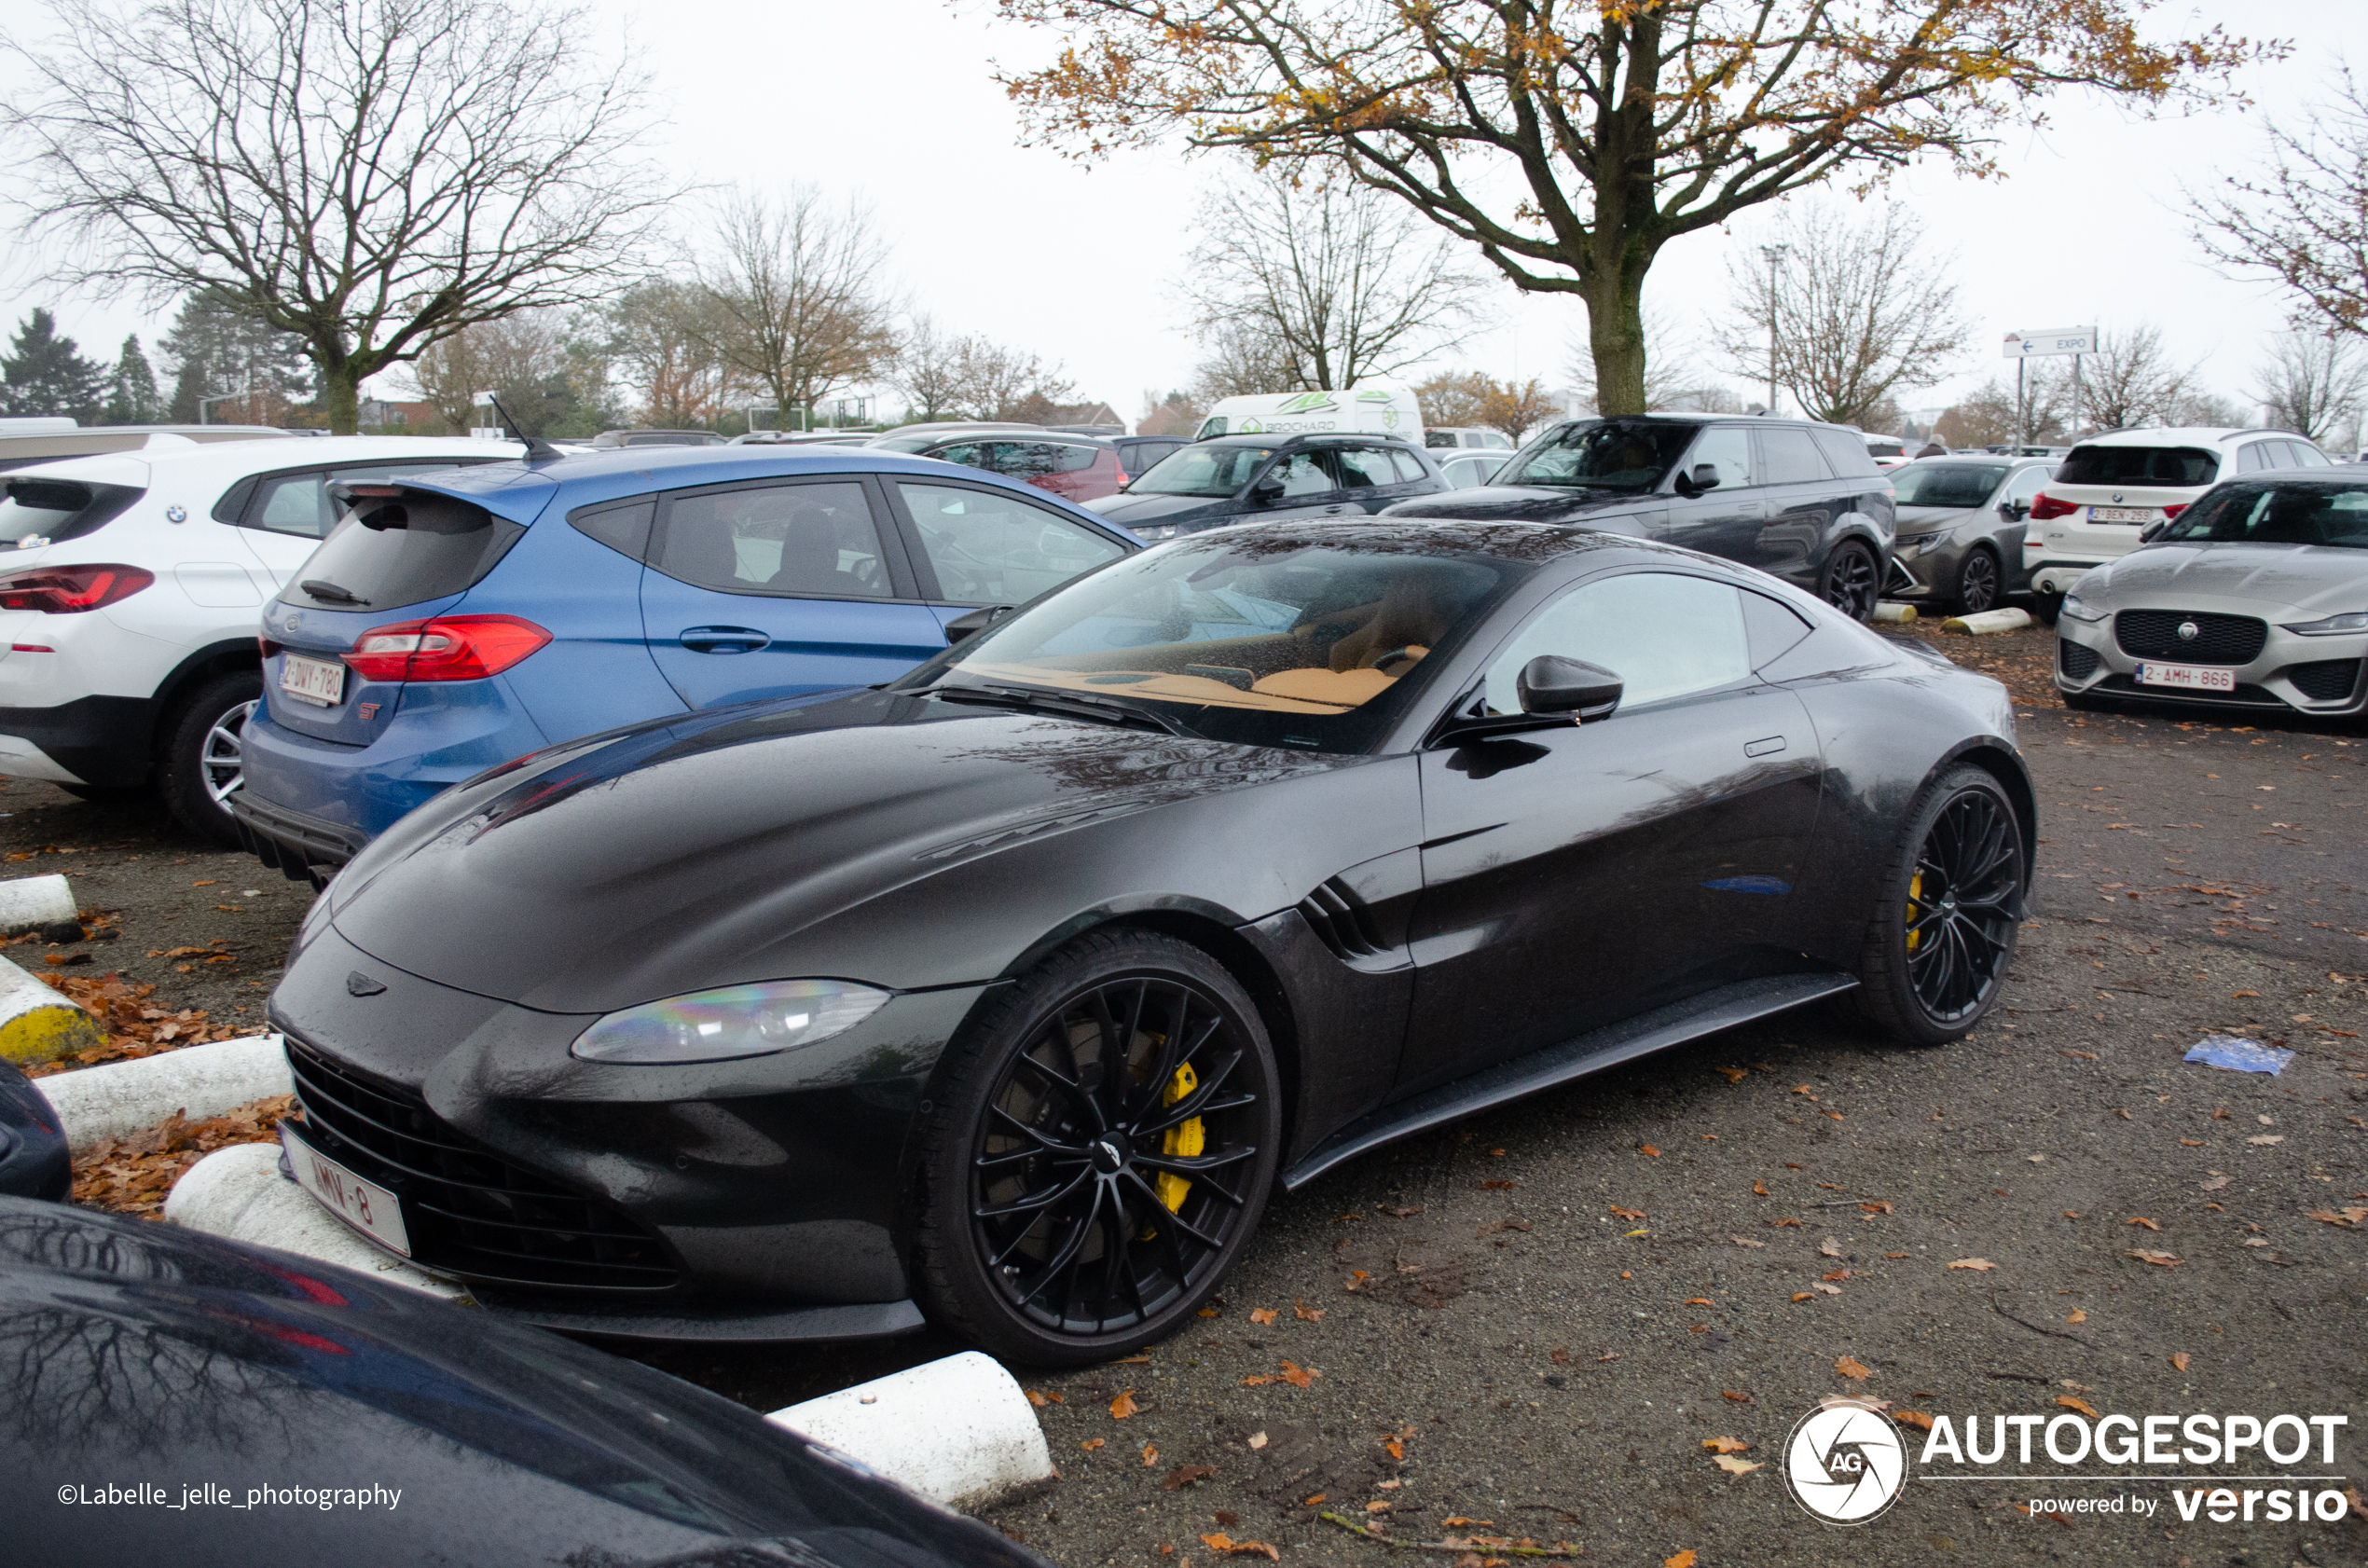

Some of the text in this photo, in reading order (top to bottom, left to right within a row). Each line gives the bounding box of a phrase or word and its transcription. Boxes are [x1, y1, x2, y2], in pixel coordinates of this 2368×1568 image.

[2057, 338, 2086, 349] EXPO
[1266, 420, 1336, 433] BROCHARD
[2145, 667, 2230, 687] 2-AMH-866
[359, 703, 381, 720] ST
